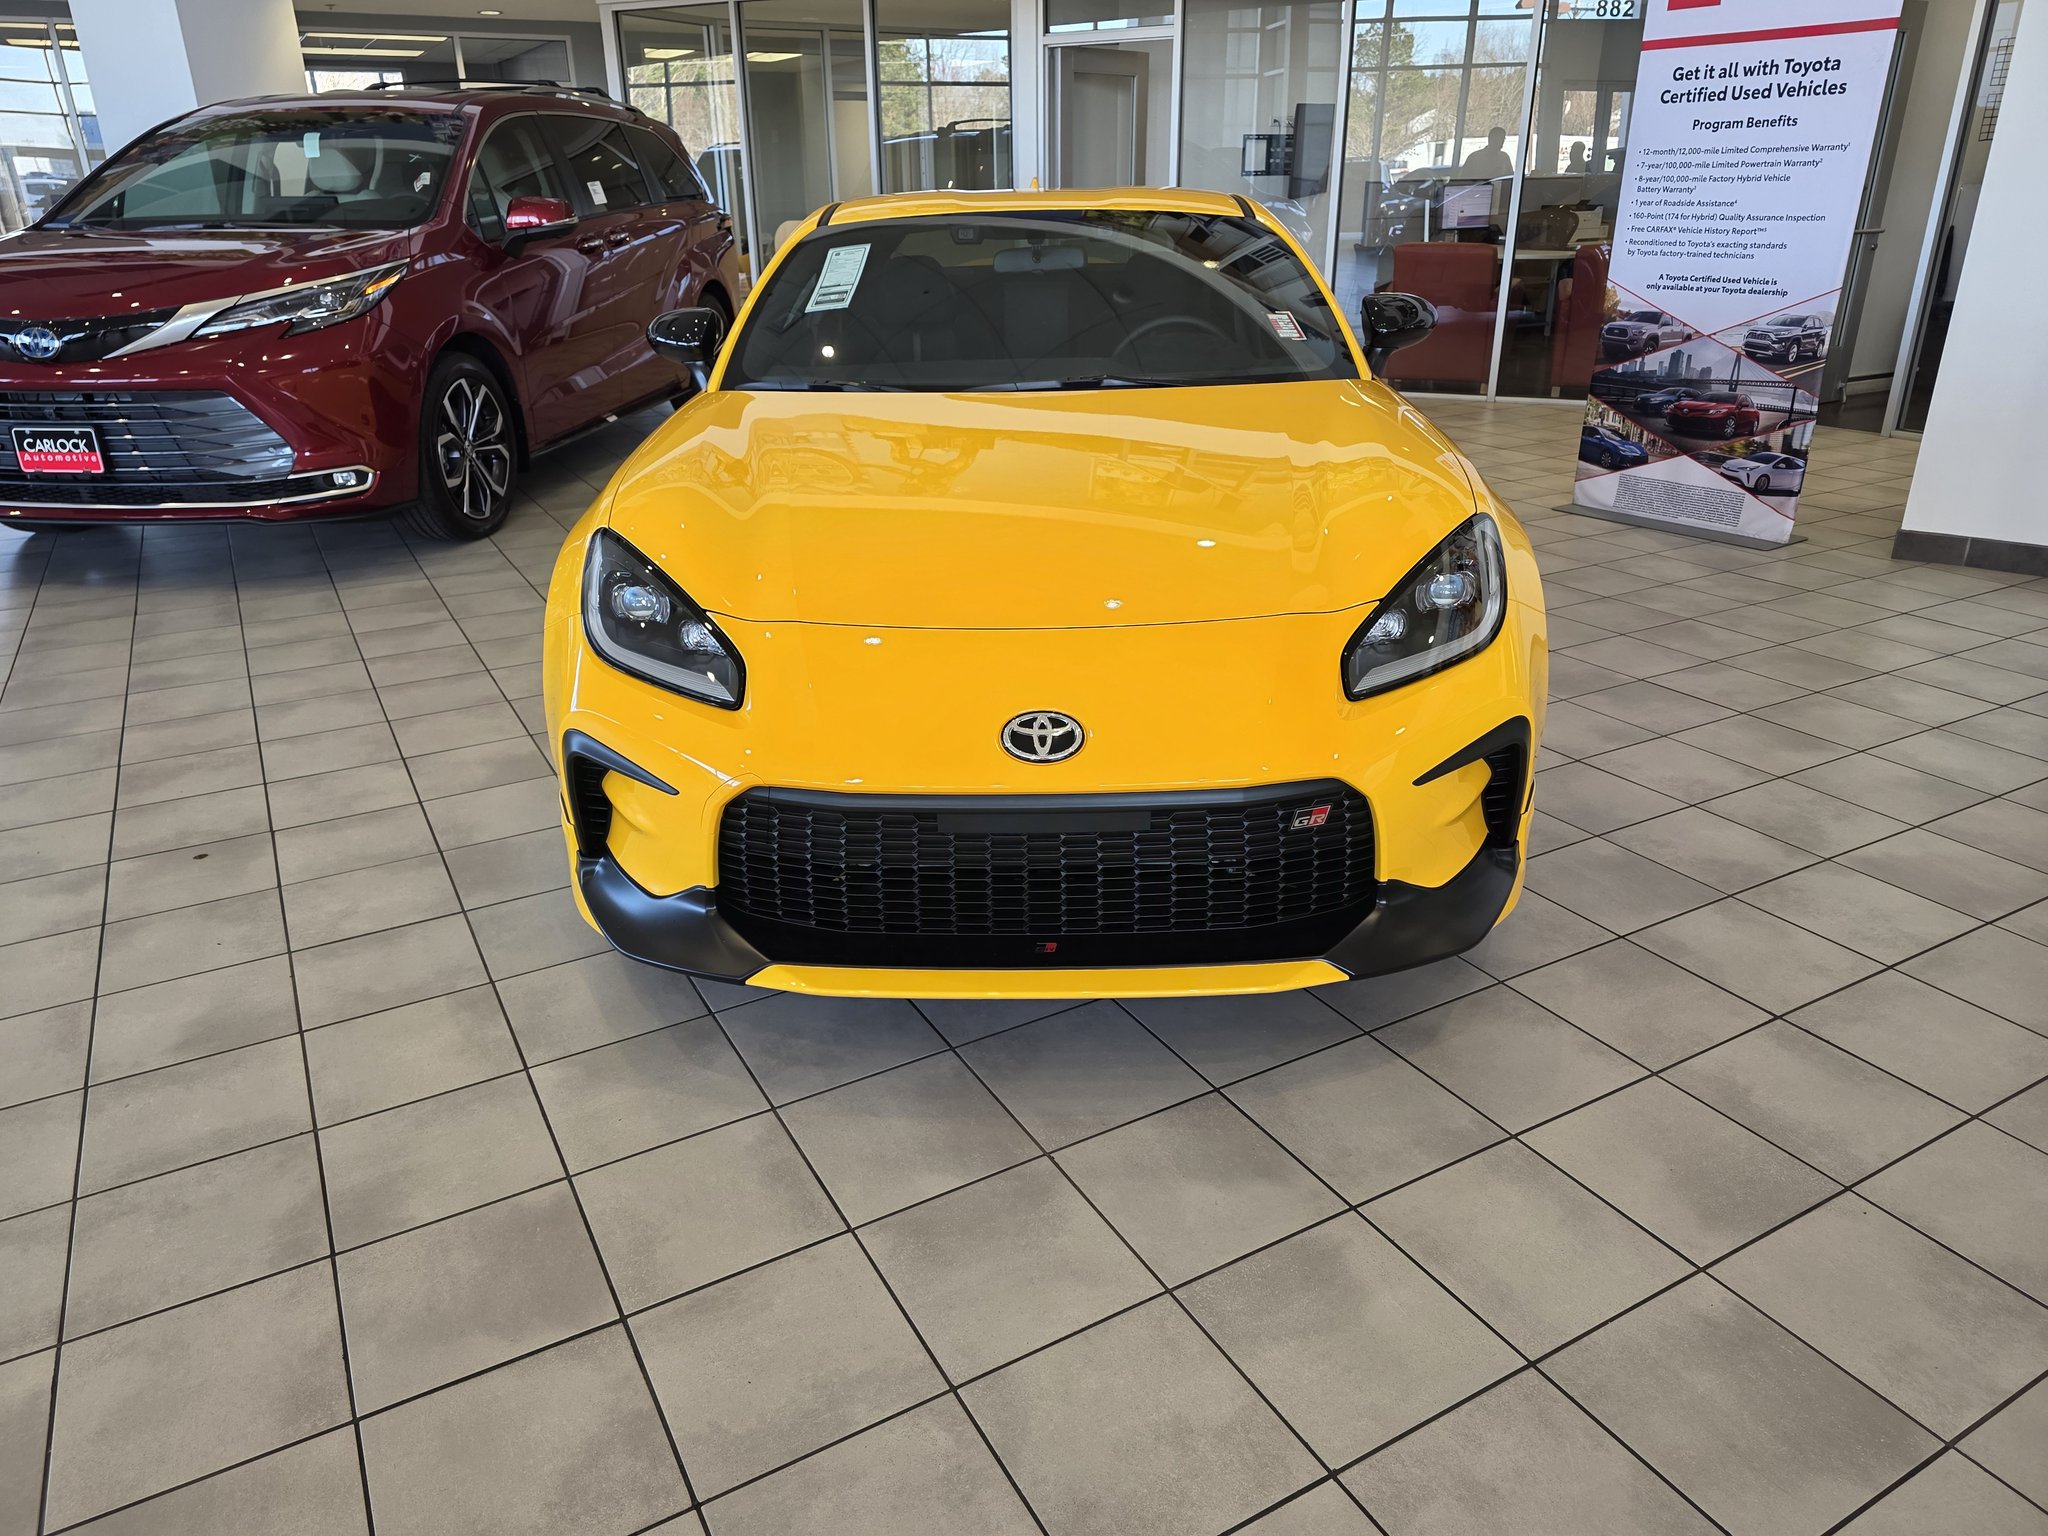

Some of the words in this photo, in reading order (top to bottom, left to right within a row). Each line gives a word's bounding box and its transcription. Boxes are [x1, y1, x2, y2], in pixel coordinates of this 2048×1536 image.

[1596, 0, 1635, 17] 882
[1672, 66, 1700, 81] Get
[1703, 64, 1715, 80] it
[1718, 62, 1739, 78] all
[1743, 59, 1779, 76] with
[1784, 56, 1841, 77] Toyota
[1660, 86, 1728, 104] Certified
[1731, 83, 1772, 100] Used
[1776, 79, 1847, 98] Vehicles
[1692, 118, 1743, 132] Program
[1746, 114, 1798, 128] Benefits
[1643, 146, 1719, 156] 12-month/12,000-mile
[1721, 145, 1749, 155] Limited
[1750, 144, 1810, 154] Comprehensive
[1640, 161, 1710, 170] 7-year/100,000-mile
[1711, 160, 1739, 169] Limited
[1740, 159, 1782, 168] Powertrain
[1638, 174, 1707, 184] 8-year/100,000-mile
[1708, 174, 1735, 184] Factory
[1736, 174, 1762, 184] Hybrid
[1763, 173, 1791, 182] Vehicle
[1636, 185, 1661, 194] Battery
[1639, 199, 1653, 207] year
[1654, 199, 1662, 207] of
[1663, 199, 1695, 207] Roadside
[1633, 212, 1664, 220] 160-Point
[1665, 212, 1679, 221] (174
[1691, 213, 1717, 222] Hybrid)
[1719, 213, 1745, 222] Quality
[1785, 213, 1826, 223] Inspection
[1678, 226, 1703, 234] Vehicle
[1704, 227, 1730, 236] History
[1629, 238, 1677, 247] Reconditioned
[1687, 240, 1715, 249] Toyota's
[1716, 241, 1748, 250] exacting
[1749, 241, 1788, 250] standards
[1627, 248, 1635, 256] by
[1637, 248, 1658, 257] Toyota
[1659, 249, 1712, 258] factory-trained
[1713, 251, 1755, 259] technicians
[1665, 274, 1688, 282] Toyota
[1690, 275, 1721, 283] Certified
[1722, 276, 1741, 284] Used
[1743, 277, 1770, 286] Vehicle
[1646, 283, 1661, 291] only
[1662, 283, 1694, 292] available
[1721, 286, 1747, 295] Toyota
[1748, 287, 1788, 297] dealership
[23, 438, 89, 453] CARLOCK
[24, 452, 97, 462] Automotive
[1293, 811, 1327, 827] GR
